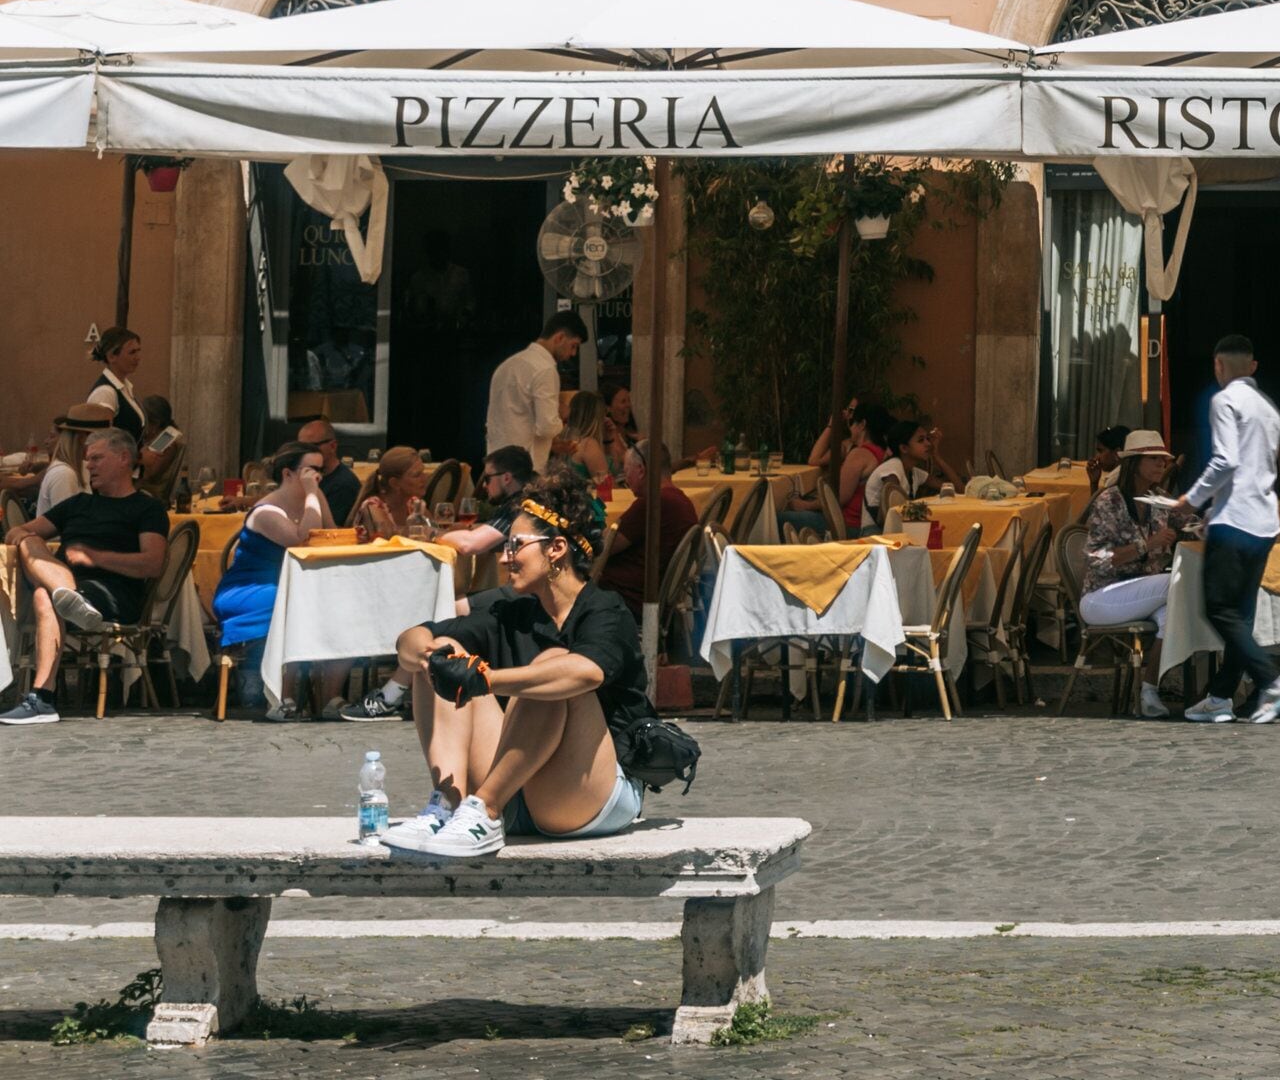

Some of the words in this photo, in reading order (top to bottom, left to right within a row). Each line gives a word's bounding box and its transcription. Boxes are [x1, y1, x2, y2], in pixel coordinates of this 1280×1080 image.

[391, 95, 743, 149] PIZZERIA
[299, 247, 356, 266] LUNC
[84, 322, 101, 342] A
[1148, 339, 1161, 358] D
